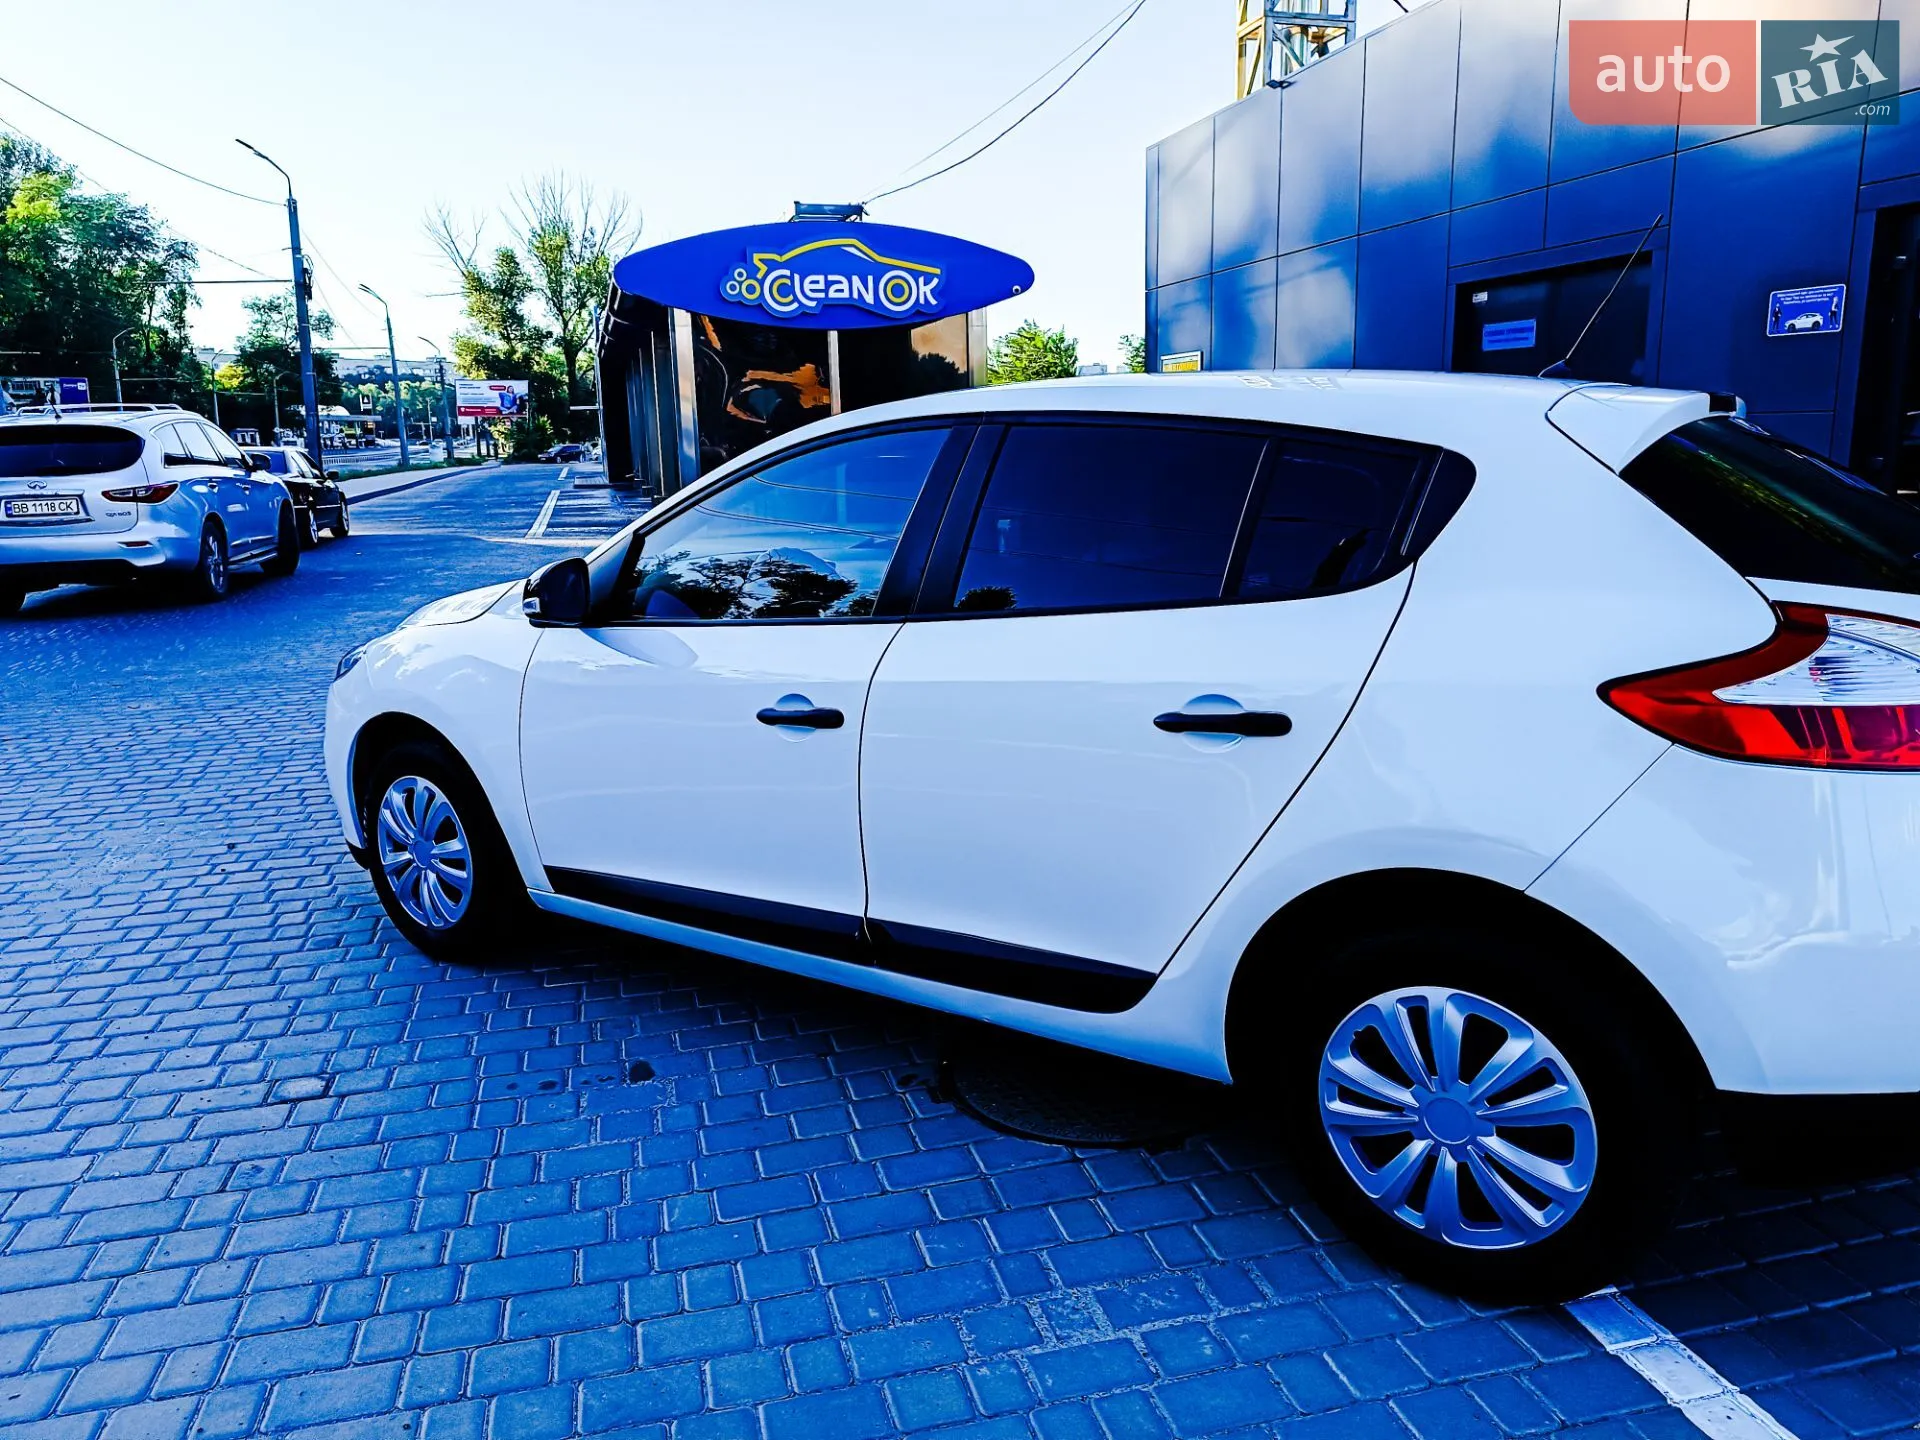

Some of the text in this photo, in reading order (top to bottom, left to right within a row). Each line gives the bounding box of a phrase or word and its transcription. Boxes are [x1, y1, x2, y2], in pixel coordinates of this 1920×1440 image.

[12, 501, 74, 514] BB 1118 CK
